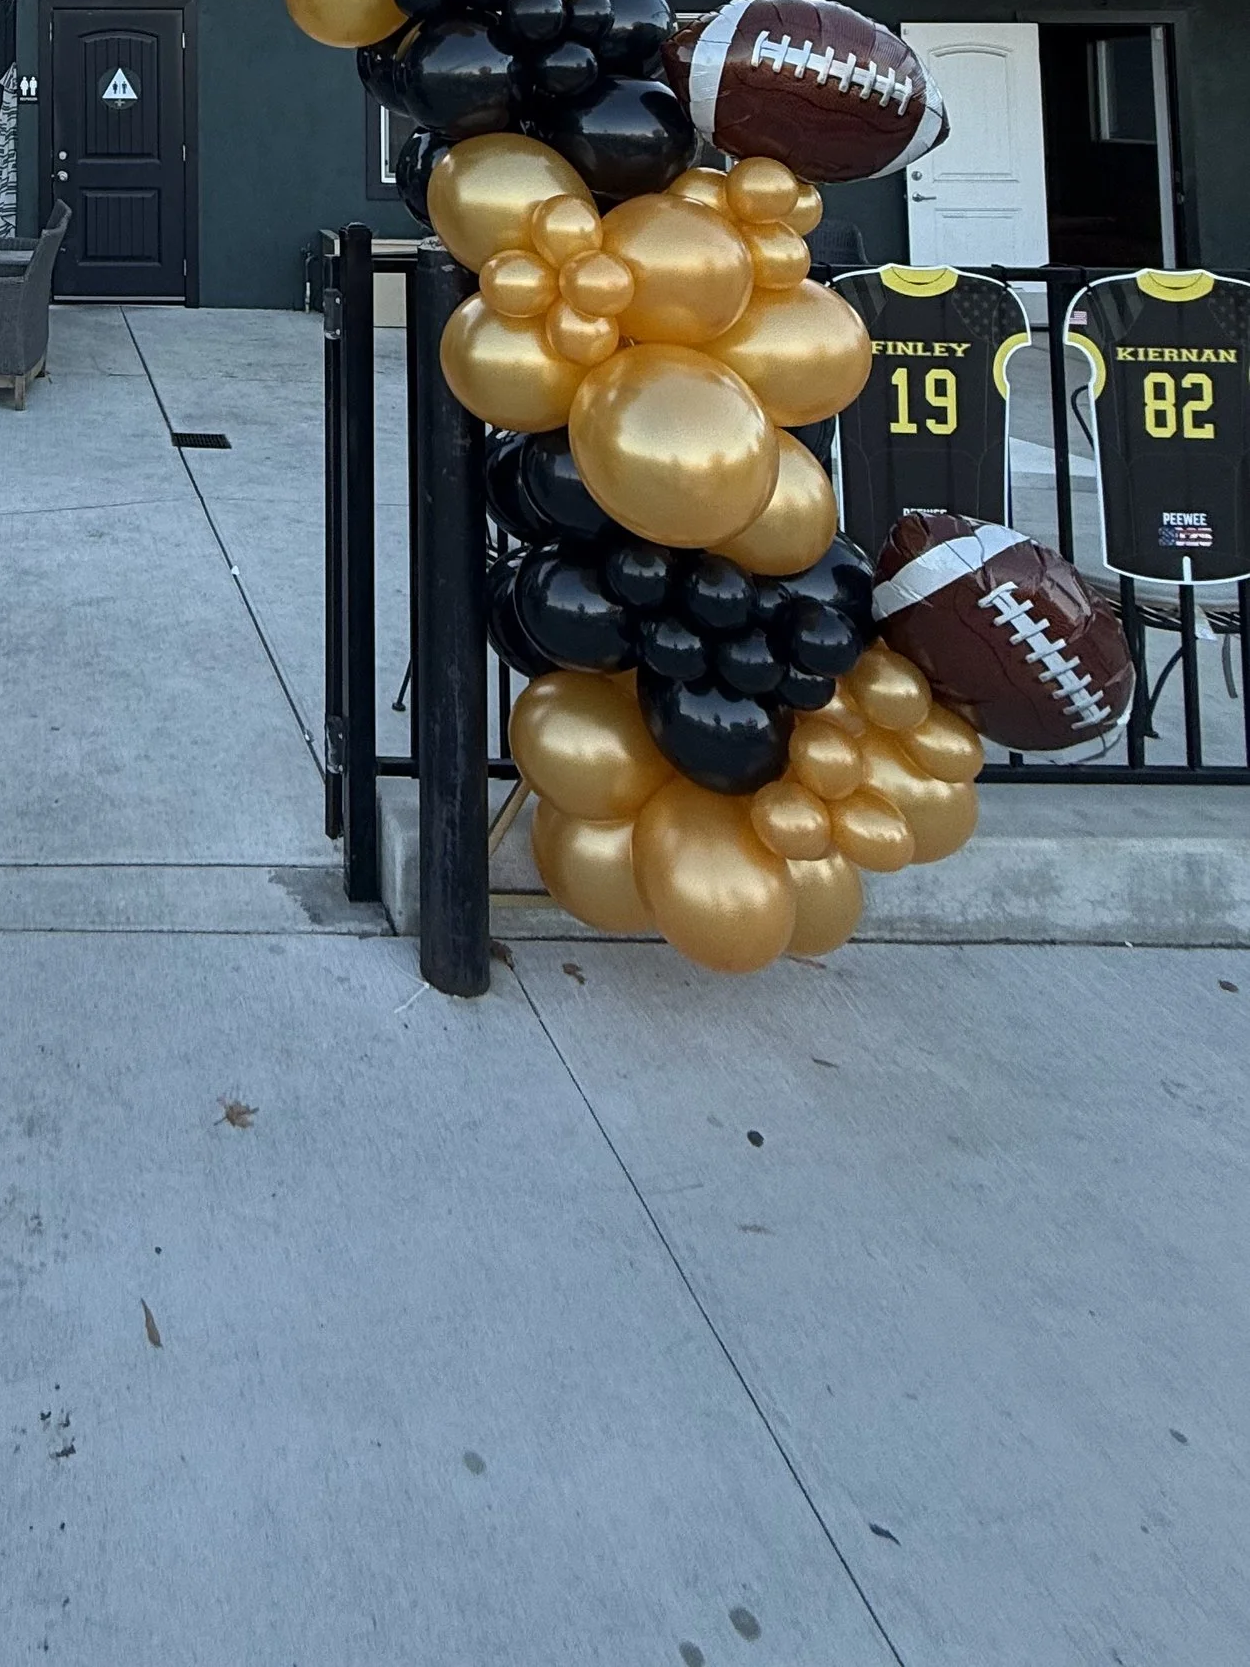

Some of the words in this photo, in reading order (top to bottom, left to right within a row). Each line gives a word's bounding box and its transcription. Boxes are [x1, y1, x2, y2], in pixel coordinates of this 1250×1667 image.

[871, 340, 971, 358] FINLEY
[1116, 347, 1237, 363] KIERNAN
[890, 367, 958, 435] 19
[1143, 372, 1215, 439] 82
[1162, 512, 1208, 526] PEEWEE
